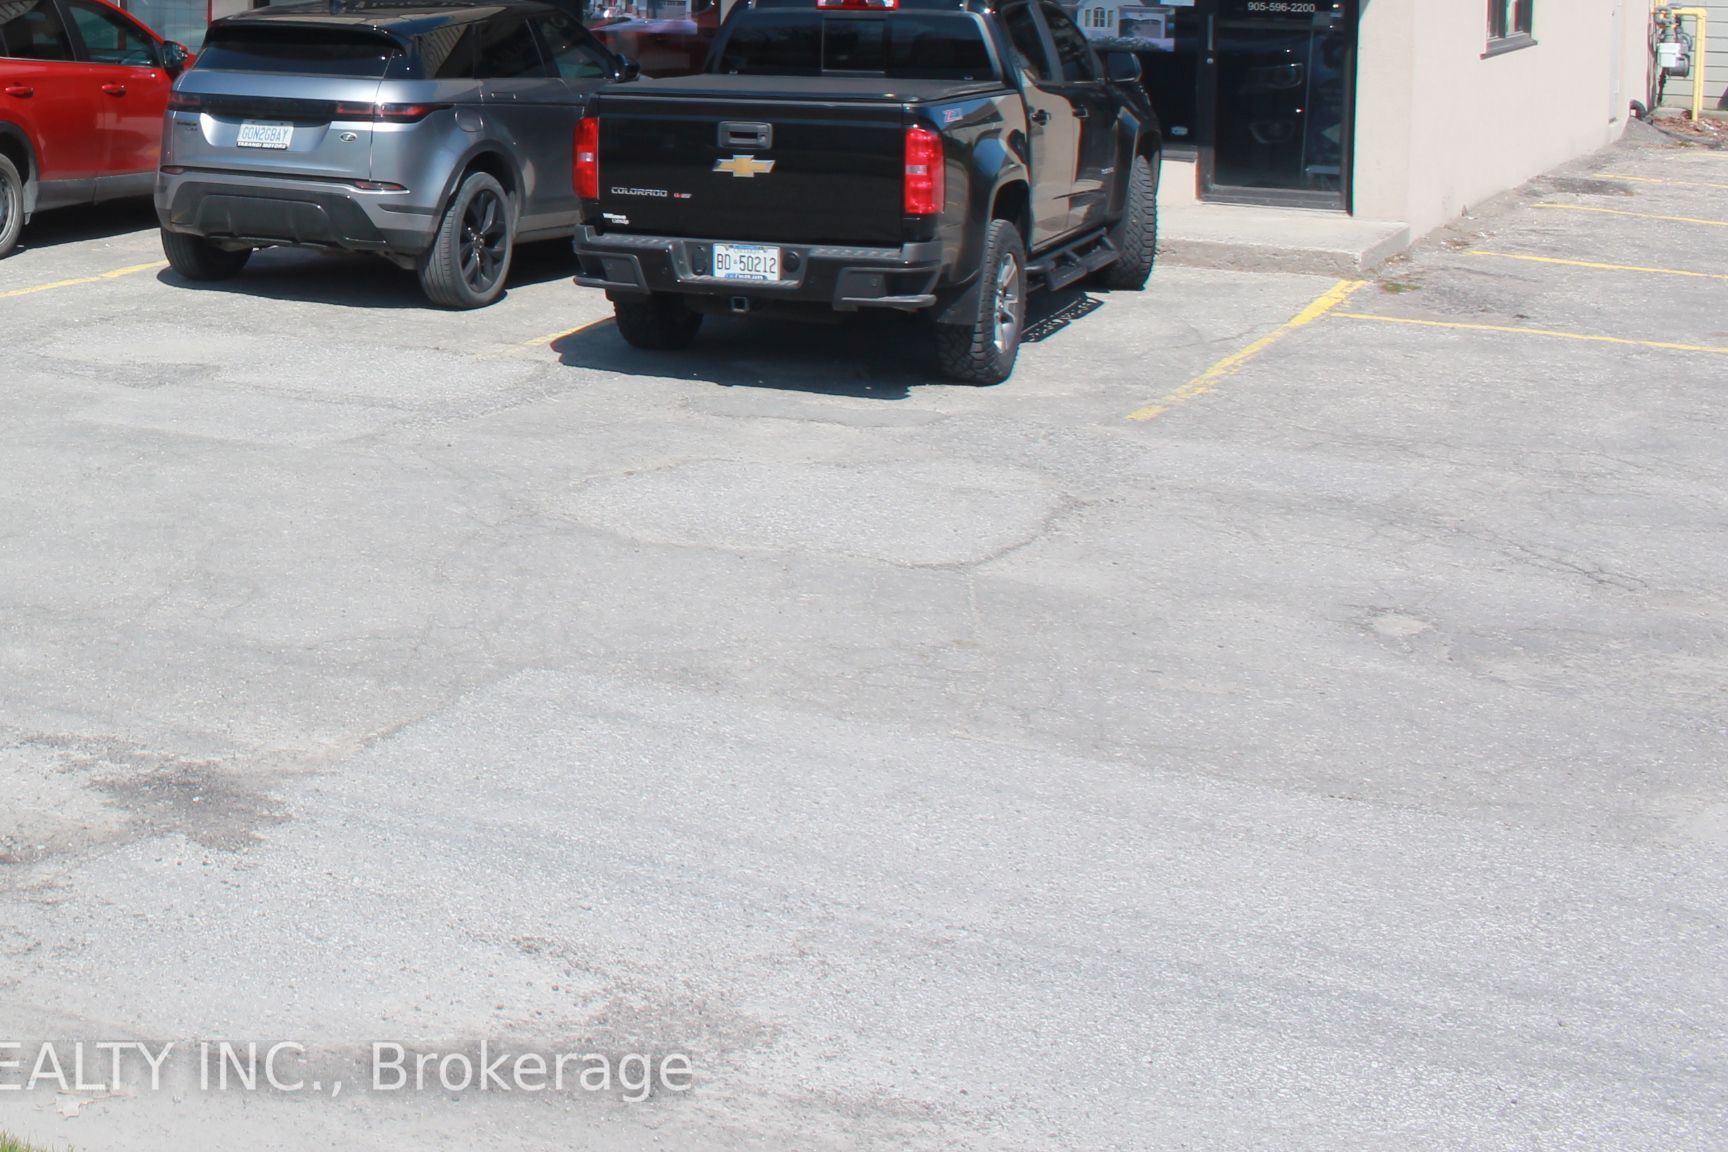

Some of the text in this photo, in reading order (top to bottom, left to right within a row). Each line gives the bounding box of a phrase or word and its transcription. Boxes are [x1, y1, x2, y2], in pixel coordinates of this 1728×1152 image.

[1247, 1, 1316, 13] 905-596-2200
[611, 186, 668, 197] COLORADO
[717, 253, 777, 274] BD 50212
